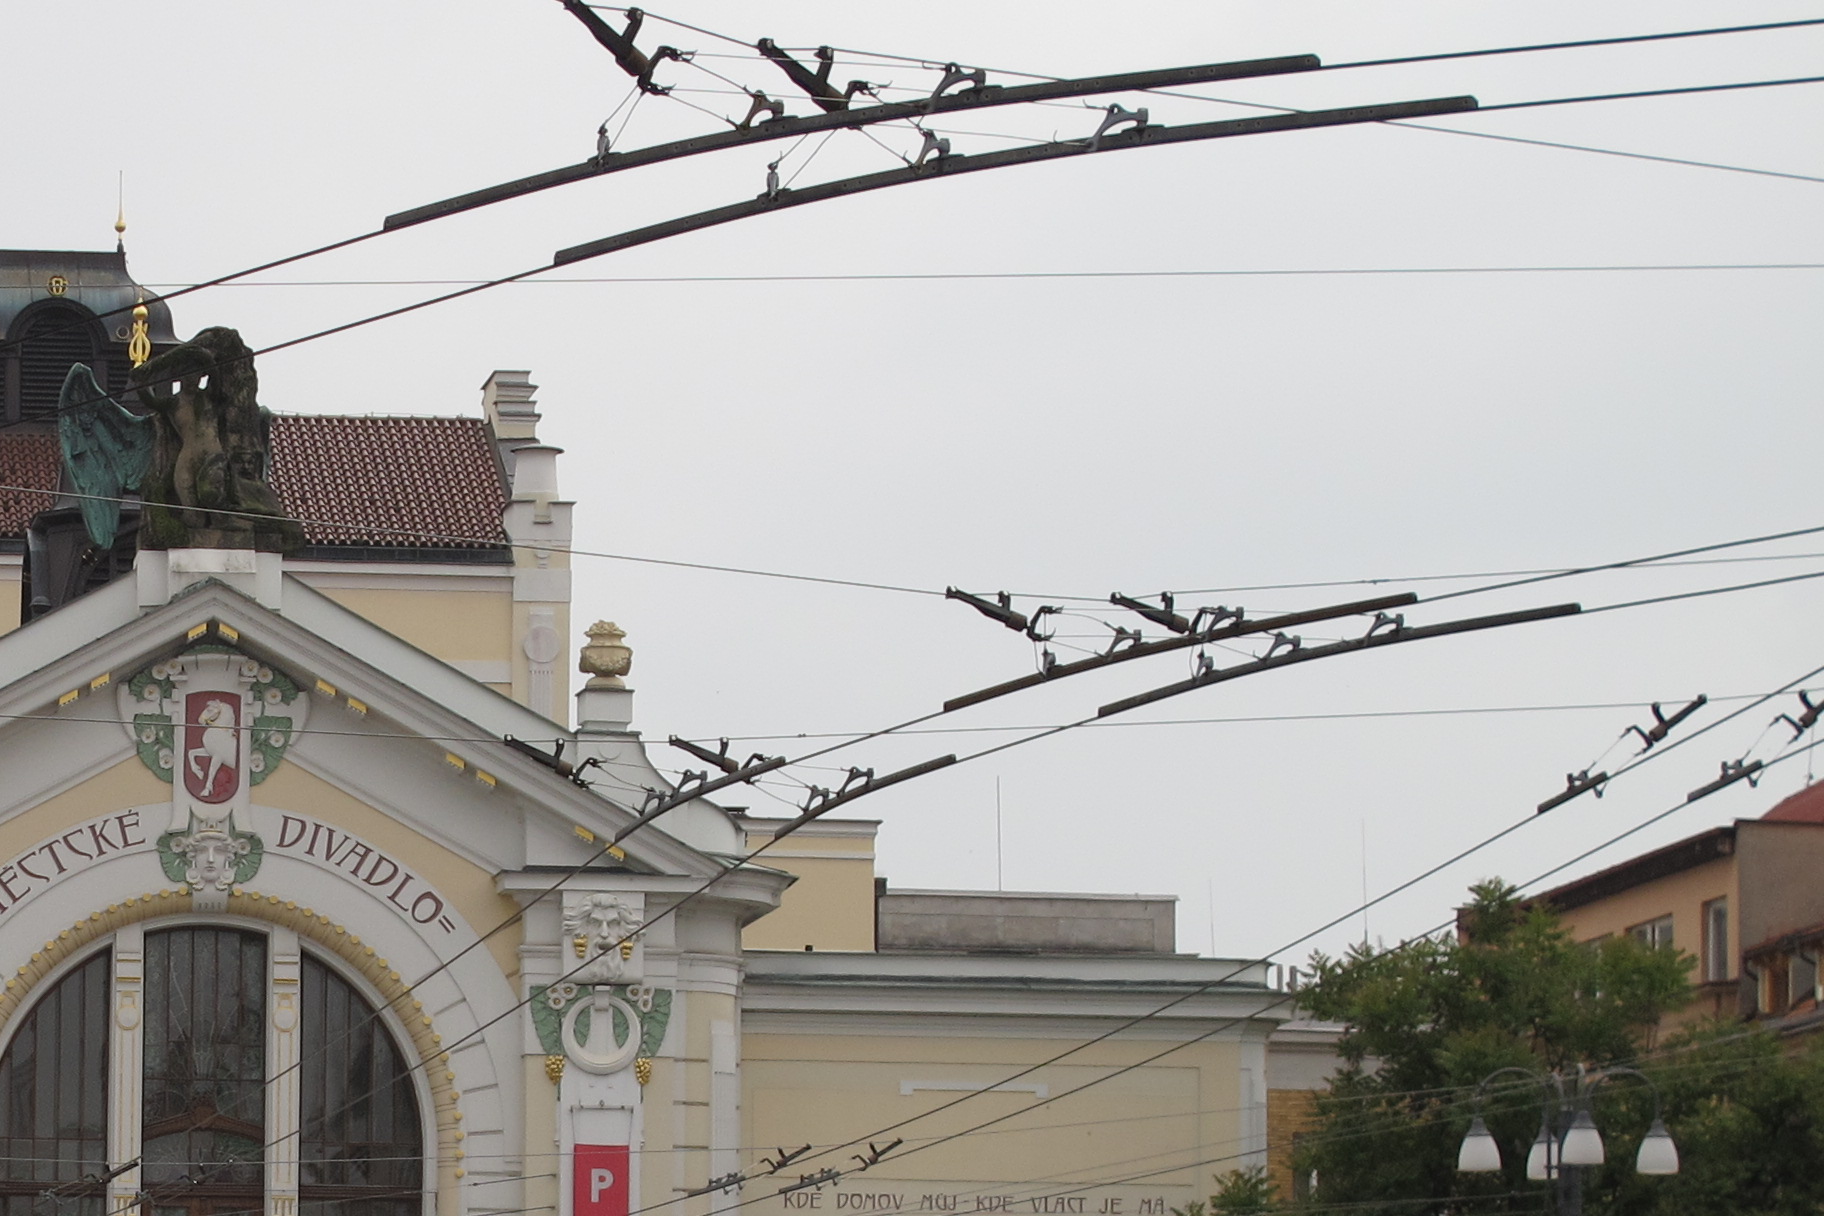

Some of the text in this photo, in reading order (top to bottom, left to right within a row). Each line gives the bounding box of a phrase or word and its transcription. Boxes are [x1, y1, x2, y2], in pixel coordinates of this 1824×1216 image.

[276, 814, 445, 925] DIVADLO
[783, 1192, 823, 1210] KDE
[836, 1193, 905, 1211] DOMOV
[976, 1195, 1015, 1213] KDE
[1098, 1197, 1123, 1215] JE
